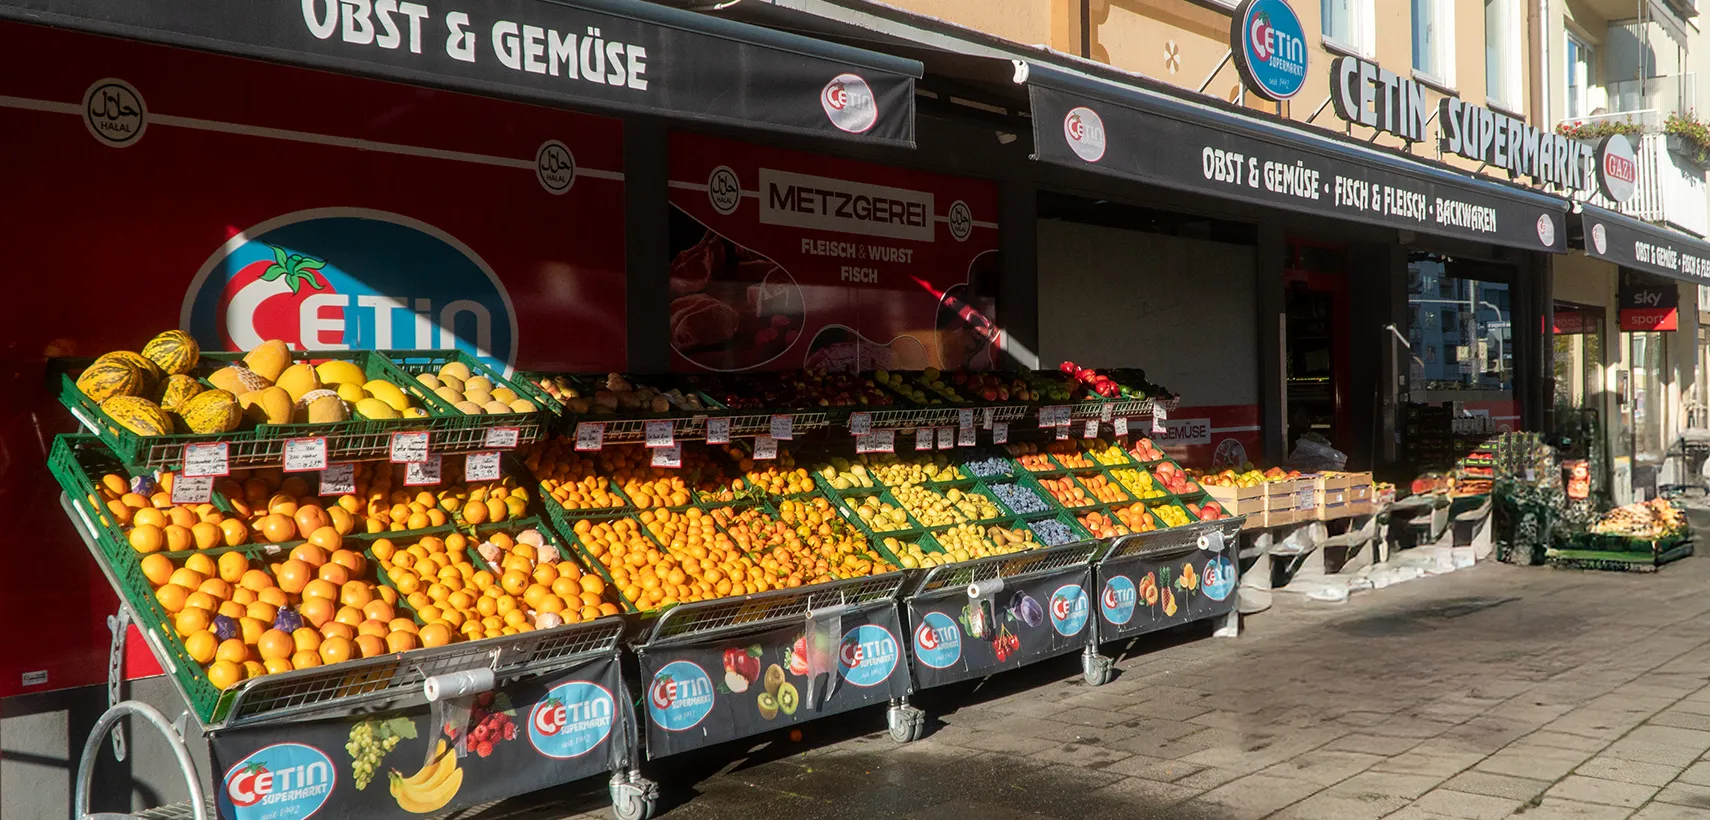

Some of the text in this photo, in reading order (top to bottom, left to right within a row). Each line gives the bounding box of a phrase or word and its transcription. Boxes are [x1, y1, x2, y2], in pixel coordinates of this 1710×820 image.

[301, 0, 649, 91] OBST & GEMÜSE
[1269, 55, 1303, 77] SUPERMARKT
[101, 122, 131, 133] HALAL
[1338, 56, 1593, 190] CETIN SUPERMARKT
[547, 174, 566, 183] HALAL
[1202, 147, 1496, 233] OBST & GEMÜSE FISCH & FLEISCH BACKWAREN
[769, 182, 927, 228] METZGEREI
[801, 238, 914, 264] FLEISCH & WURST
[1635, 241, 1650, 263] OBST
[1651, 245, 1656, 265] &
[1656, 246, 1677, 270] GEMÜSE
[1682, 253, 1696, 275] FISCH
[840, 265, 878, 284] FISCH
[1634, 290, 1662, 306] sky
[1631, 314, 1664, 325] sport
[860, 654, 894, 668] SUPERMARKT
[671, 694, 711, 709] SUPERMARKT
[561, 716, 610, 735] SUPERMARKT
[262, 783, 328, 805] SUPERMARKT
